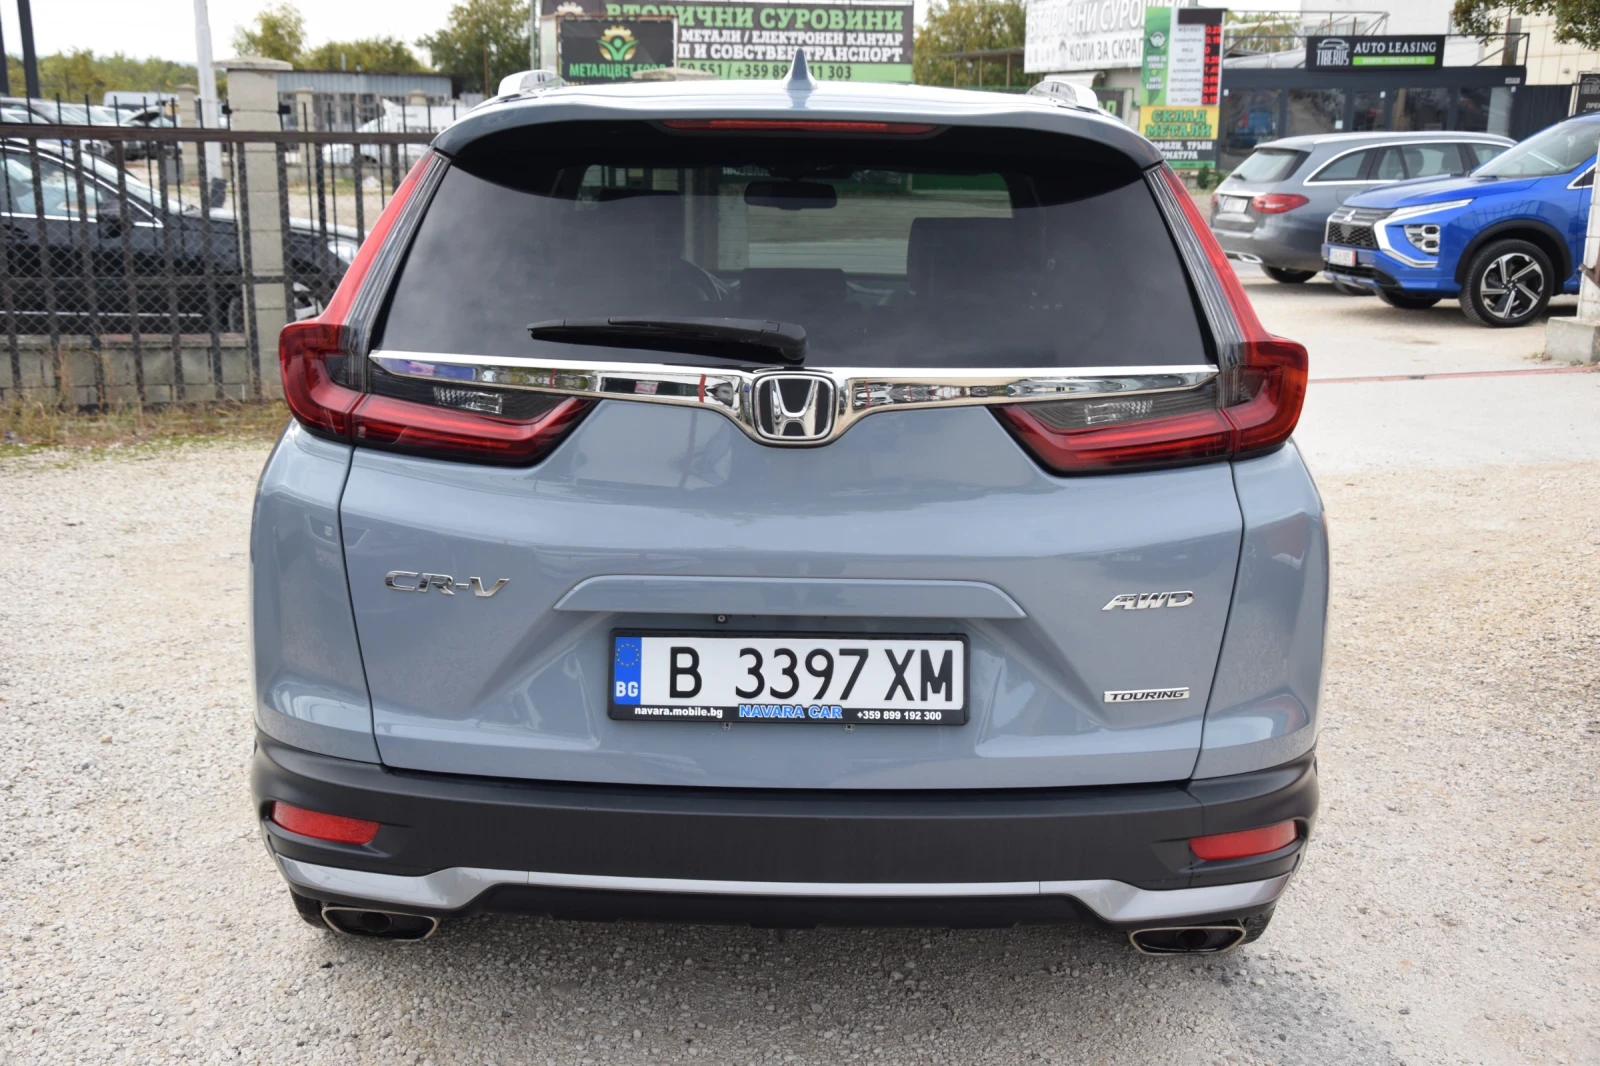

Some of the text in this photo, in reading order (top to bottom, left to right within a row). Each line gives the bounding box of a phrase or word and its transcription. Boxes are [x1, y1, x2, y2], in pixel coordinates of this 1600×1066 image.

[760, 9, 904, 31] СУРОВИНИ
[681, 28, 742, 44] МЕТАЛИ
[751, 31, 844, 46] ЕЛЕКТРОНЕН
[846, 32, 904, 46] КАНТАР
[805, 47, 904, 63] ТРАНСПОРТ
[1069, 43, 1095, 61] КОЛИ
[1097, 41, 1109, 60] ЗА
[1353, 41, 1437, 54] AUTO LEASING
[569, 63, 634, 79] МЕТАЛЦВЕТ
[736, 65, 768, 78] +359
[828, 66, 852, 78] 303
[1152, 110, 1207, 123] СКЛАД
[1145, 124, 1212, 138] МЕТАЛИ
[385, 570, 510, 597] CR-V
[1102, 591, 1195, 610] AWD
[669, 646, 953, 702] B 3397 XM
[615, 682, 639, 697] BG
[1110, 690, 1184, 701] TOURING
[634, 704, 942, 720] navara.mobile.bg NAVARA CAR +359 899 192 300
